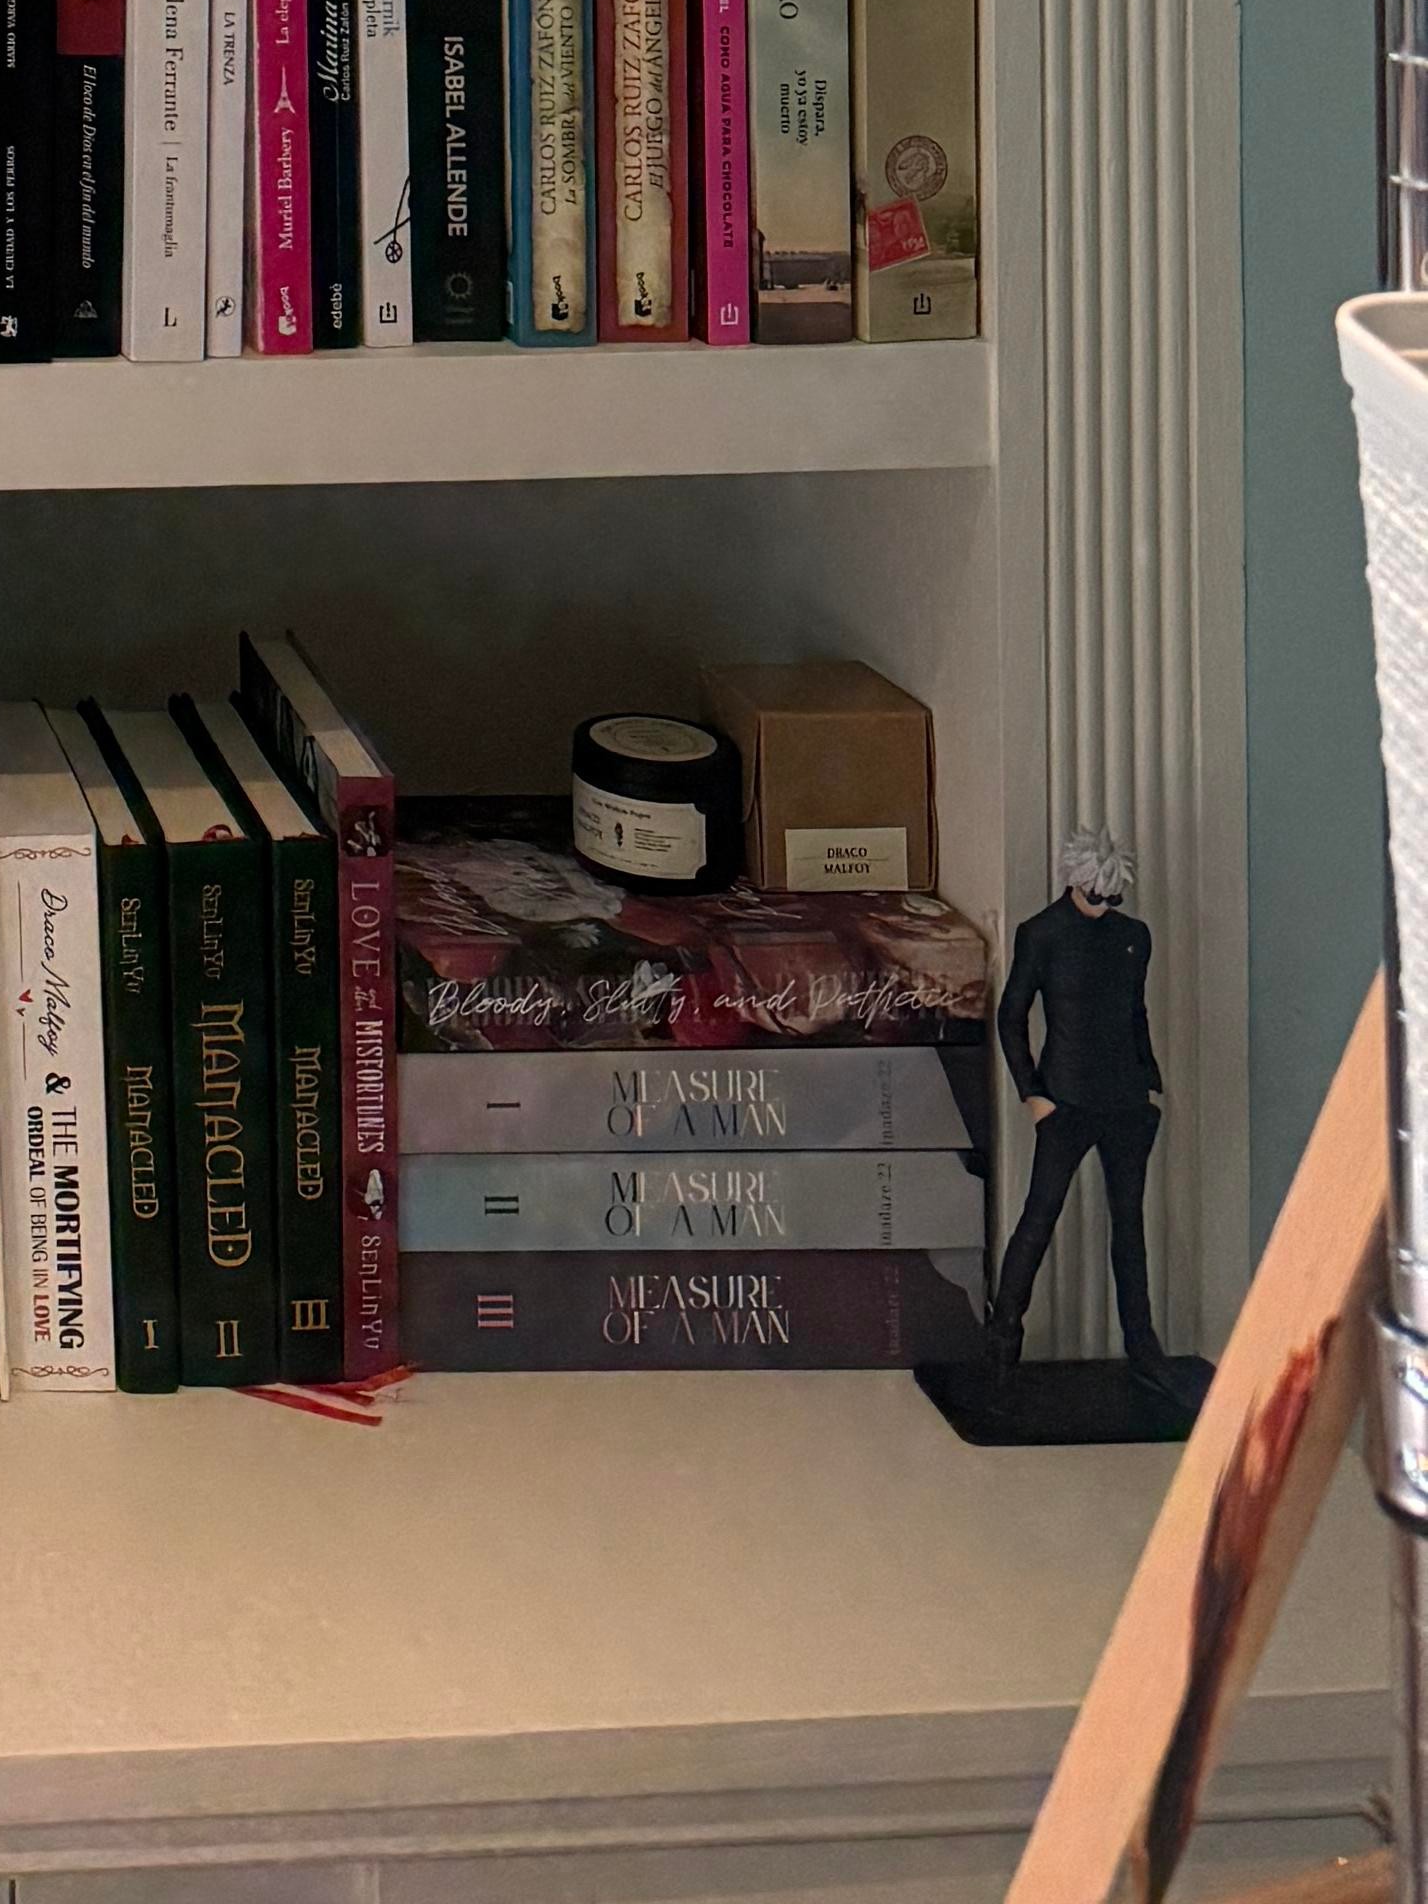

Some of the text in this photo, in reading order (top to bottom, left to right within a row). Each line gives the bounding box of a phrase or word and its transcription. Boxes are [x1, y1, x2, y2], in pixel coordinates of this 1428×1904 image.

[163, 47, 184, 132] Ferrante
[444, 36, 468, 237] ISABEL ALLENDE
[824, 861, 871, 875] MALFOY
[826, 847, 867, 858] DRACO
[350, 882, 381, 977] LOVE
[38, 889, 85, 1349] Draco Malfoy & THE MORTIFYING
[355, 1020, 384, 1153] MISFORTUNES
[603, 1310, 650, 1344] OF
[707, 1310, 790, 1344] MAN
[609, 1275, 782, 1312] MEASURE
